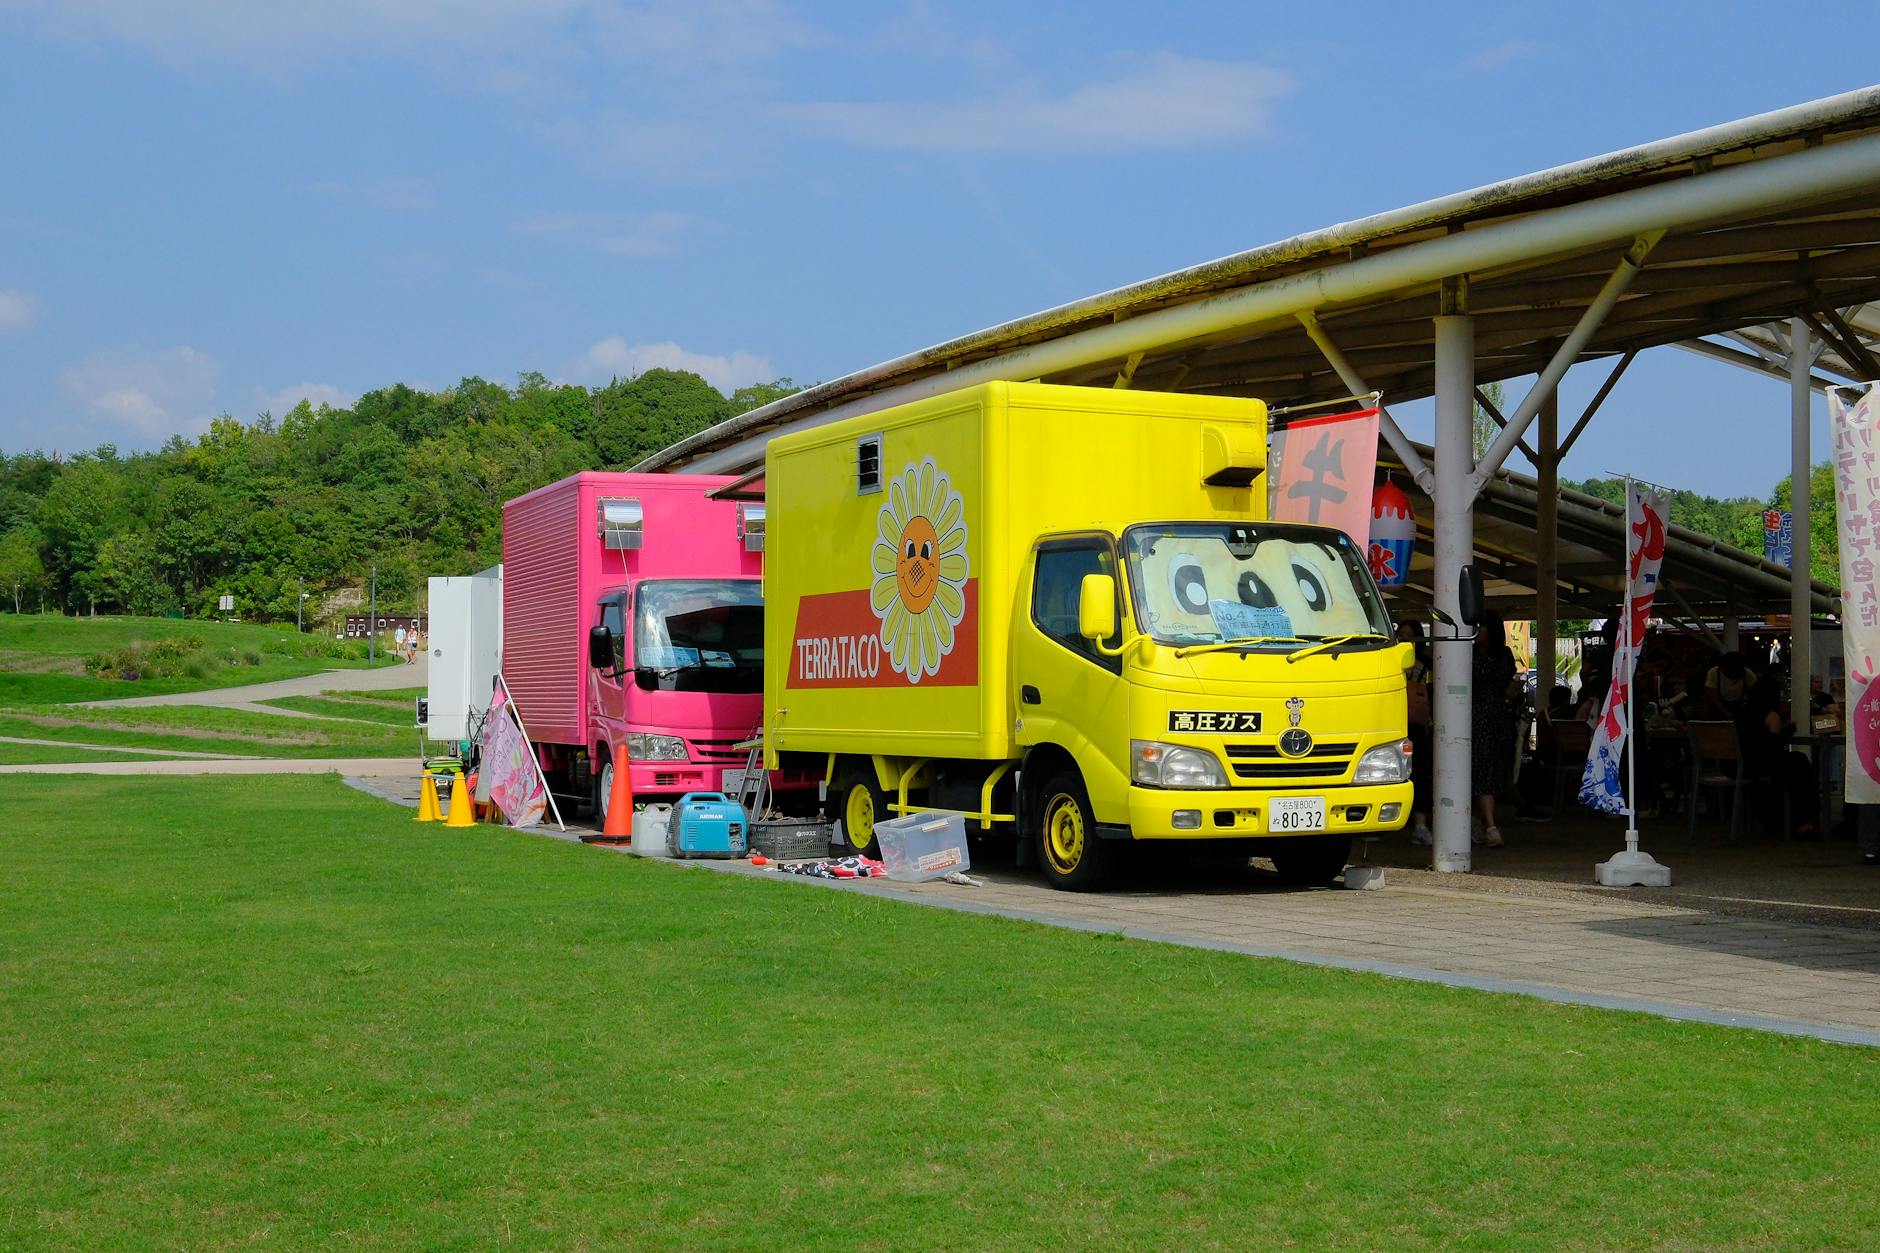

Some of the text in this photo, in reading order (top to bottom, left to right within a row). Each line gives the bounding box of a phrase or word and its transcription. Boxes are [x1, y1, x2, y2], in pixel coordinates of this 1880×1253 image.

[797, 633, 880, 680] TERRATACO
[1174, 712, 1257, 731] 高圧ガス
[1282, 811, 1322, 829] 80-32
